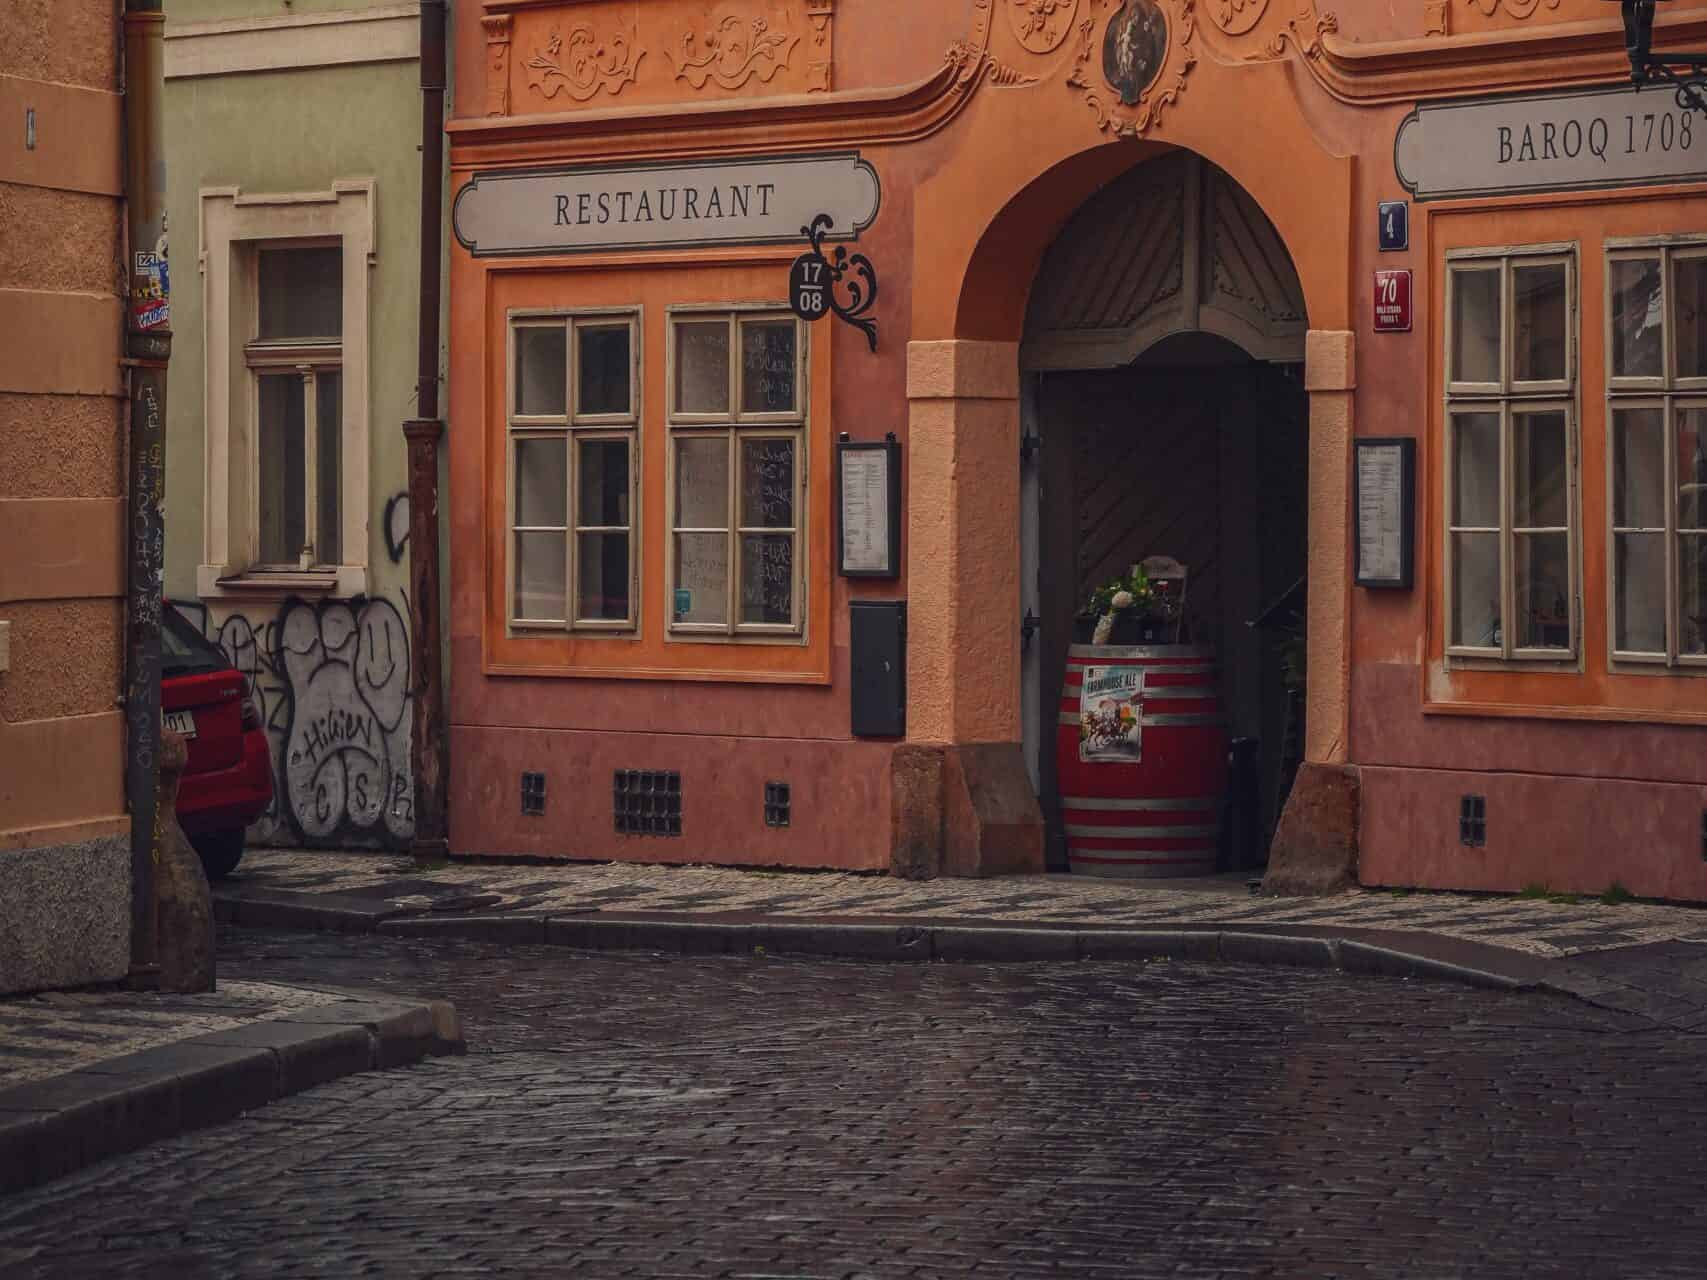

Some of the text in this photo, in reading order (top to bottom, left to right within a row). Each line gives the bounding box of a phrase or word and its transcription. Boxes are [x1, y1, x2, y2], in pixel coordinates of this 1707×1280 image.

[1497, 111, 1692, 163] BAROQ 1708
[553, 183, 775, 226] RESTAURANT
[1386, 213, 1394, 239] 4
[800, 263, 822, 284] 17
[799, 291, 823, 312] 08
[1381, 278, 1397, 303] 70
